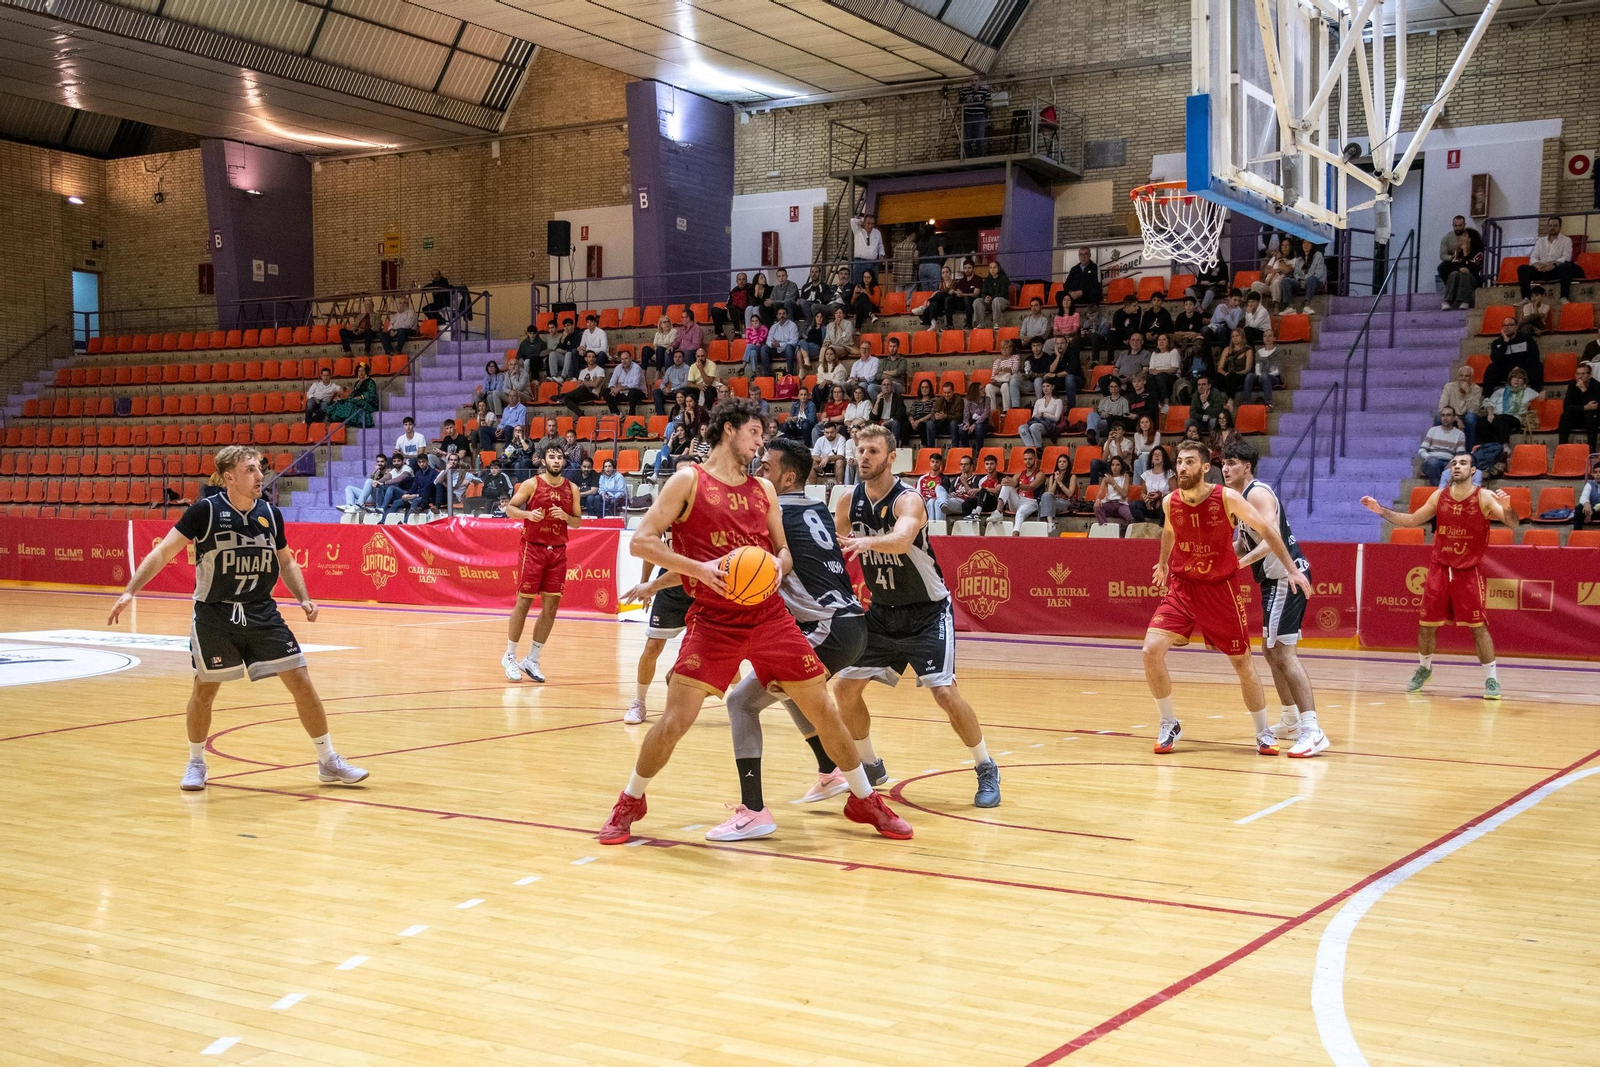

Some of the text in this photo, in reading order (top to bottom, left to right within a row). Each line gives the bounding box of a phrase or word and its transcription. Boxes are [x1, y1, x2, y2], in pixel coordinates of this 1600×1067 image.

[639, 192, 649, 209] B
[214, 234, 222, 248] B
[727, 492, 749, 511] 34
[1189, 512, 1200, 528] 11
[802, 508, 835, 550] 8
[17, 543, 46, 556] Blanca
[105, 549, 125, 558] ACM
[1189, 541, 1211, 553] Jaén
[222, 549, 273, 575] PINAR
[458, 565, 500, 580] Blanca
[584, 568, 611, 579] ACM
[875, 567, 896, 590] 41
[234, 574, 259, 596] 77
[957, 575, 1008, 599] JAENCB
[1029, 587, 1090, 597] CAJA RURAL
[1108, 580, 1169, 598] Blanca
[1489, 588, 1515, 599] UNED
[1046, 598, 1072, 608] JAÉN
[1376, 596, 1408, 606] PABLO
[1472, 610, 1480, 618] 13
[1231, 639, 1239, 648] 11
[802, 654, 816, 668] 34
